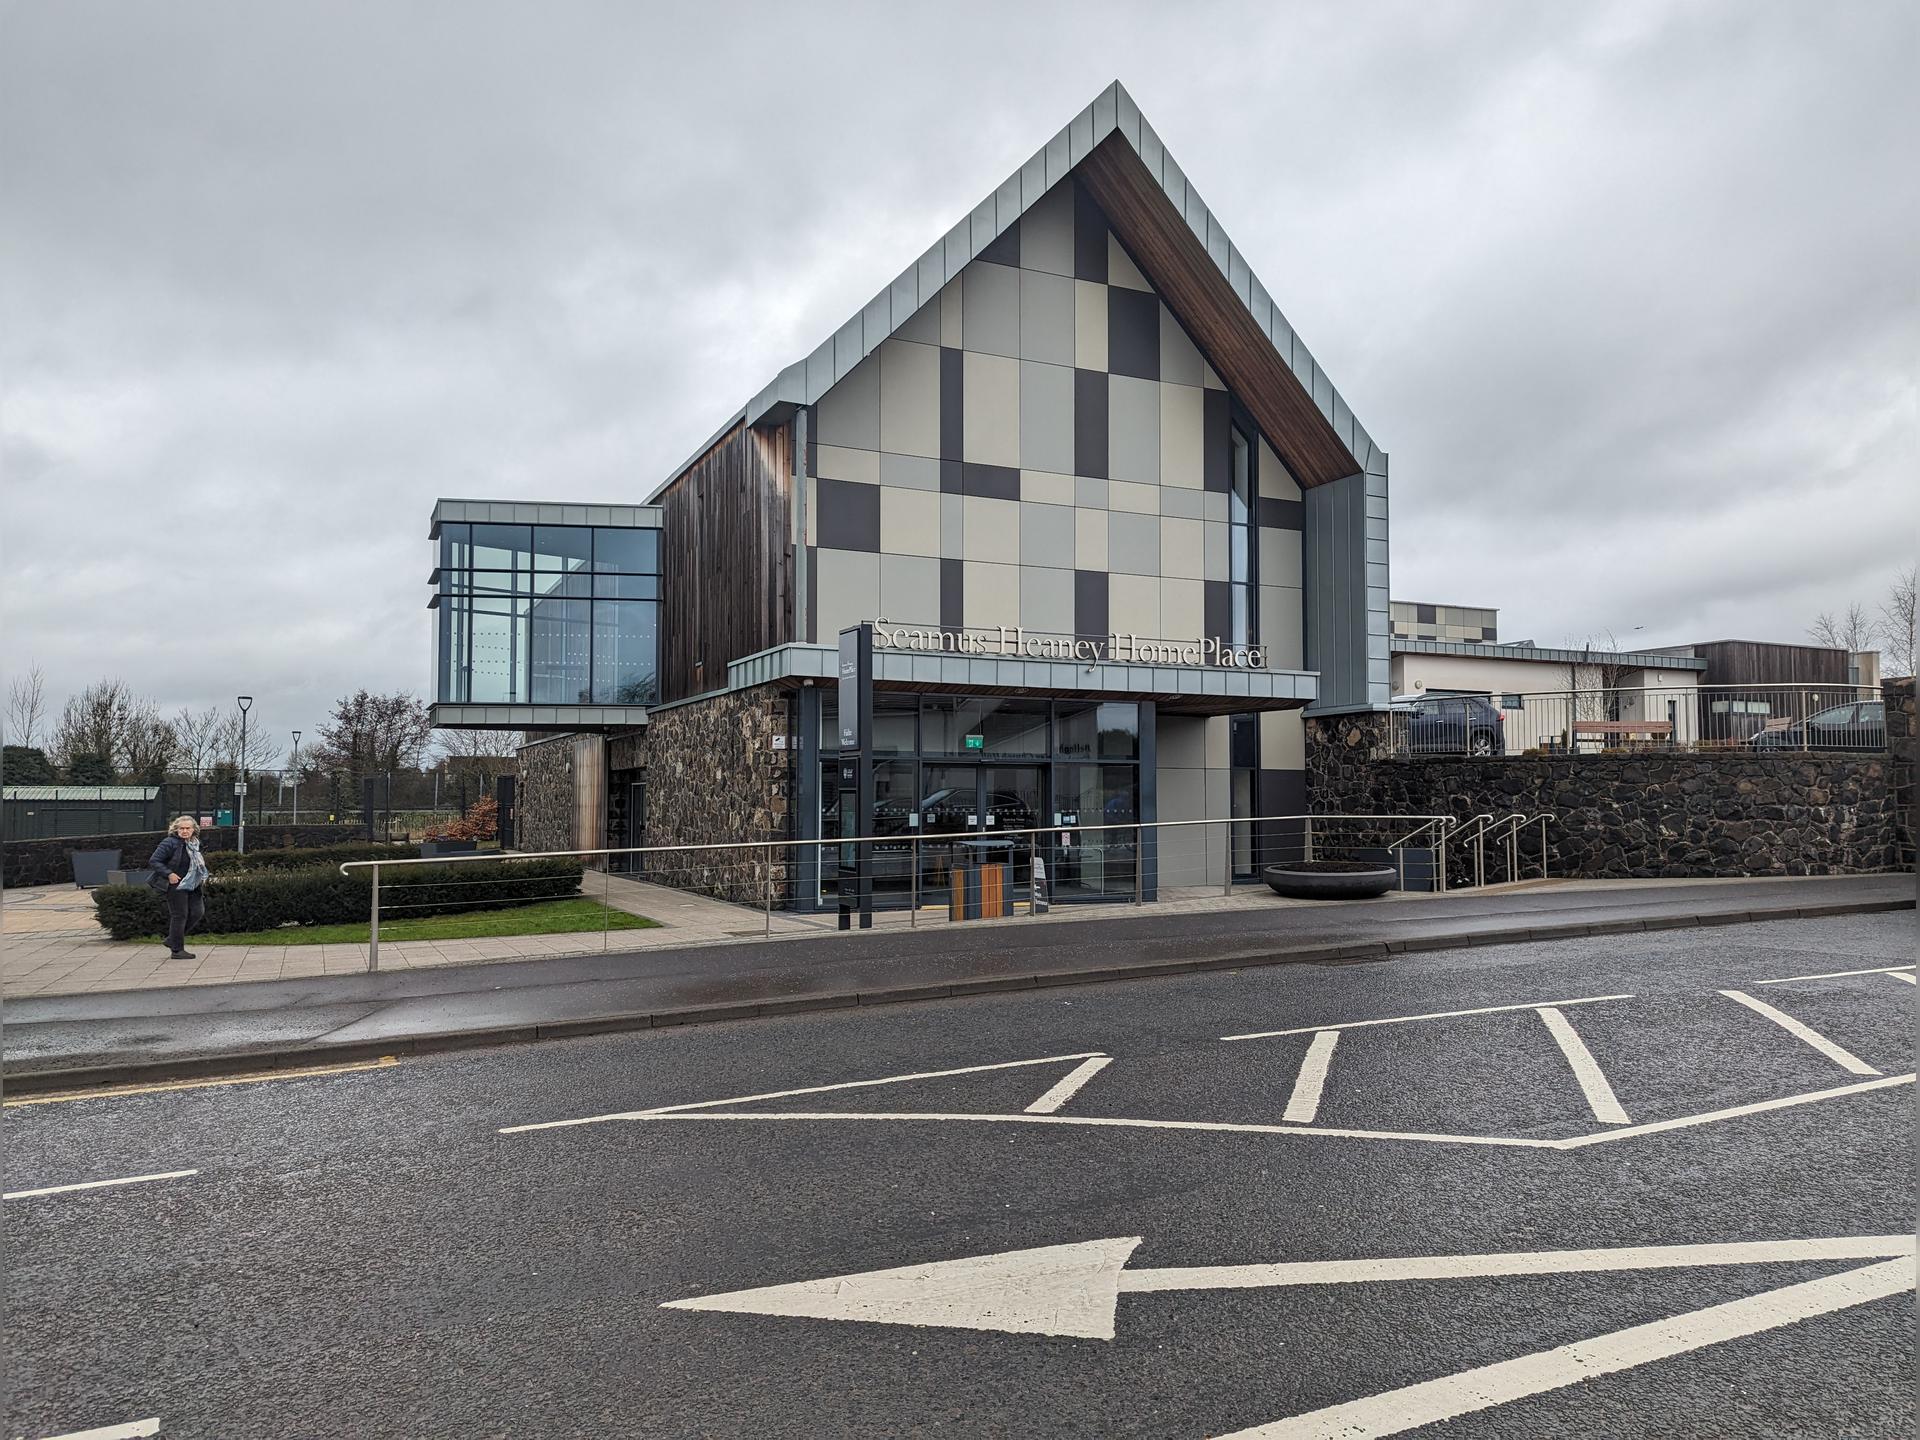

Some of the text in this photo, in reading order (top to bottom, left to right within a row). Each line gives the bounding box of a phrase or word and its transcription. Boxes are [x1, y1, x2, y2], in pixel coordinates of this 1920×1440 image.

[875, 616, 1261, 672] Seamus Heaney HomePlace
